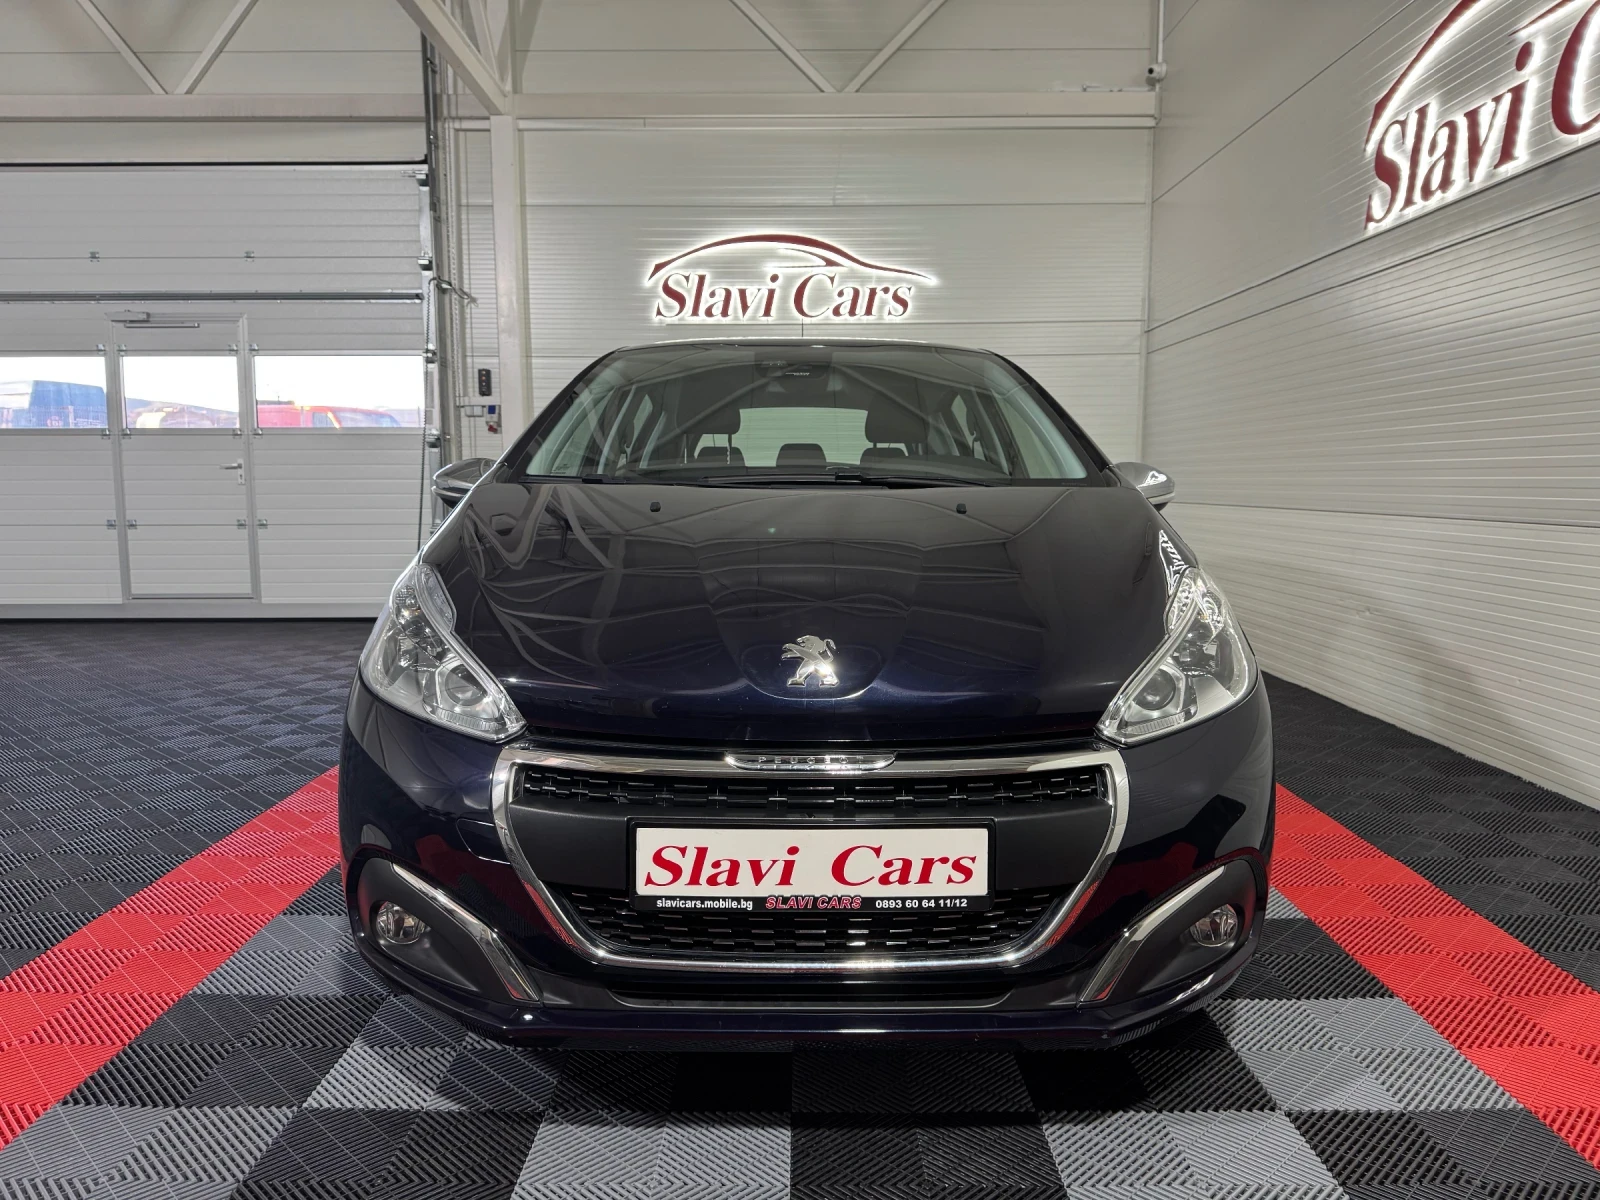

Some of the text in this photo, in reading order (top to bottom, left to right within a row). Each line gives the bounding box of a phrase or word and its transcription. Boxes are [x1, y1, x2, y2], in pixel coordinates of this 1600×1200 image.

[1364, 40, 1533, 231] Slavi
[654, 272, 913, 319] Slavi Cars
[644, 845, 977, 887] Slavi Cars
[656, 896, 968, 911] slavicars.mobile.bg SLAVI CARS 0893 60 64 11/12
